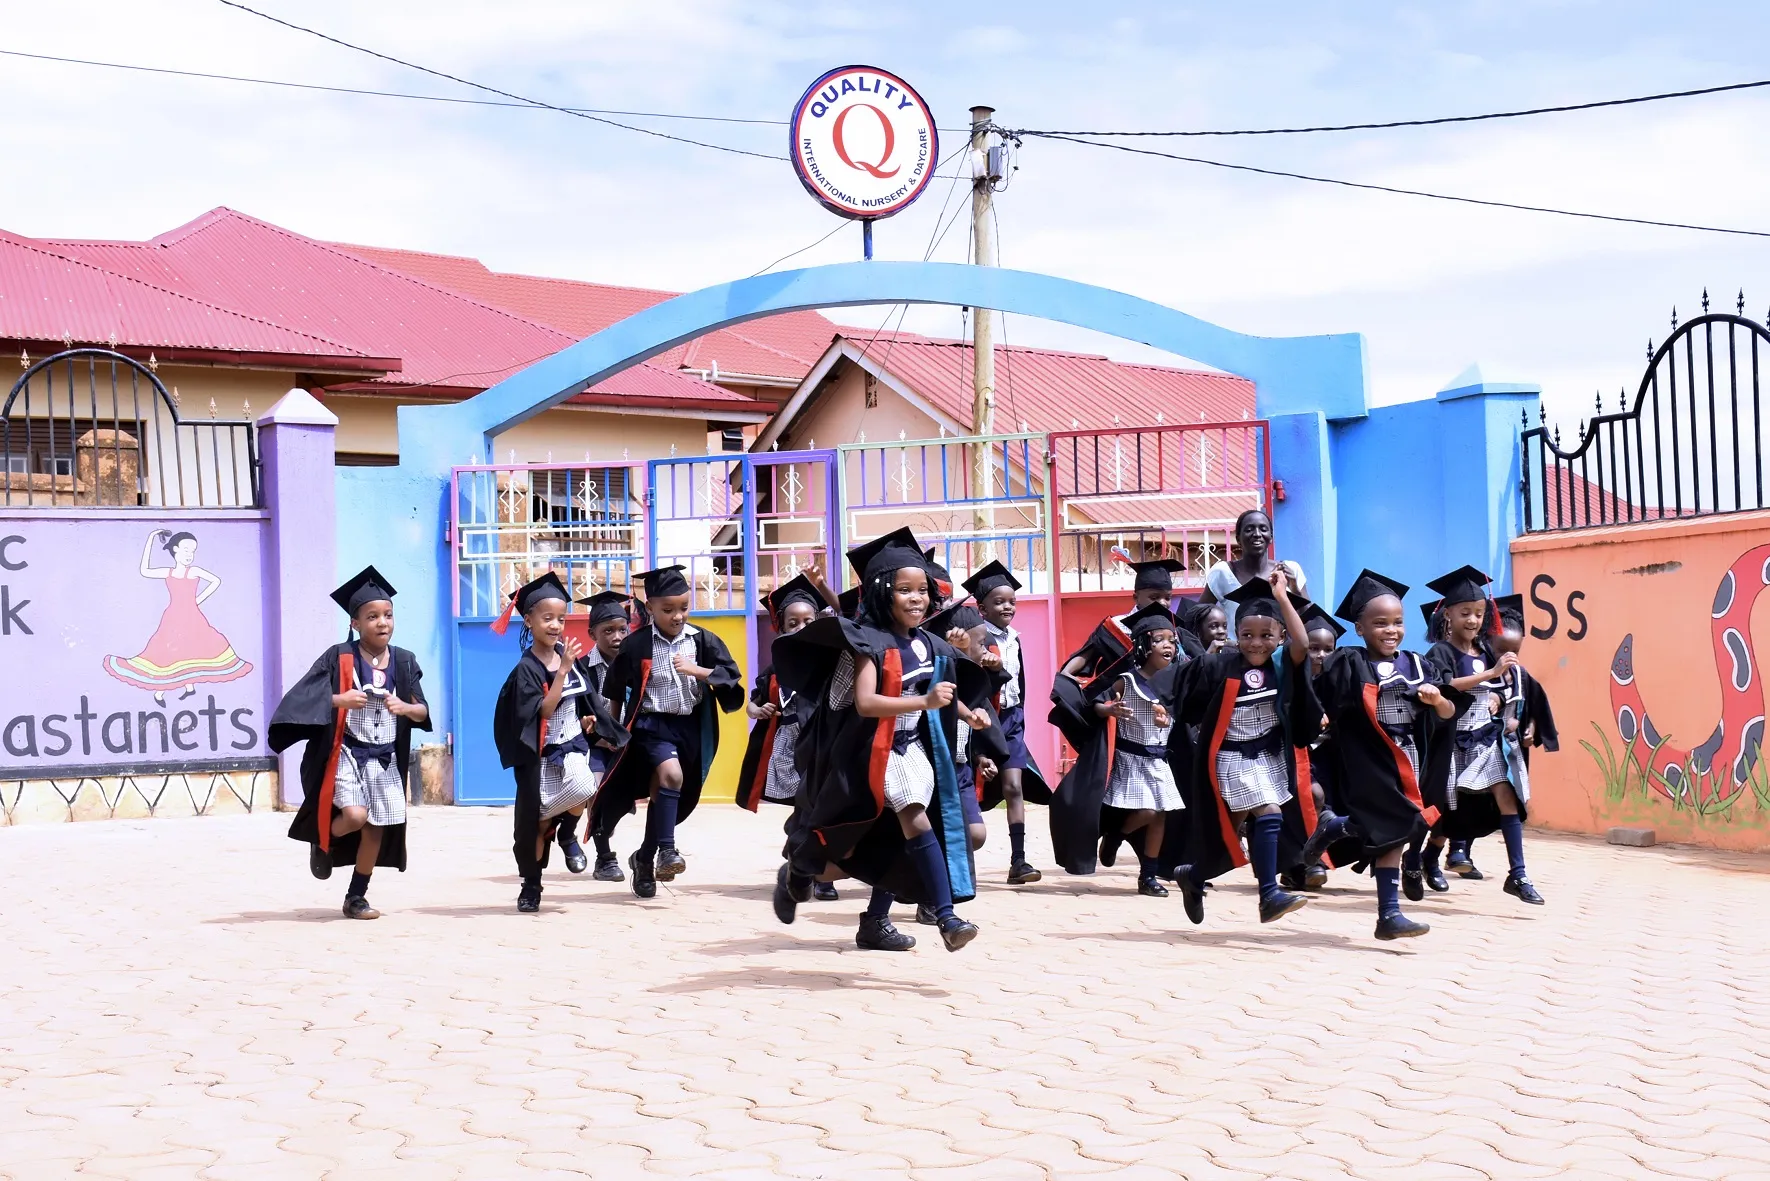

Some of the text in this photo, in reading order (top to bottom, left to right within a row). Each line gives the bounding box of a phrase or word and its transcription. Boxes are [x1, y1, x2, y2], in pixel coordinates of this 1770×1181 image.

[811, 76, 914, 118] QUALITY
[803, 127, 928, 207] INTERNATIONAL NURSERY & DAYCARE
[832, 103, 901, 179] Q
[0, 584, 34, 636] k
[1530, 573, 1588, 641] Ss
